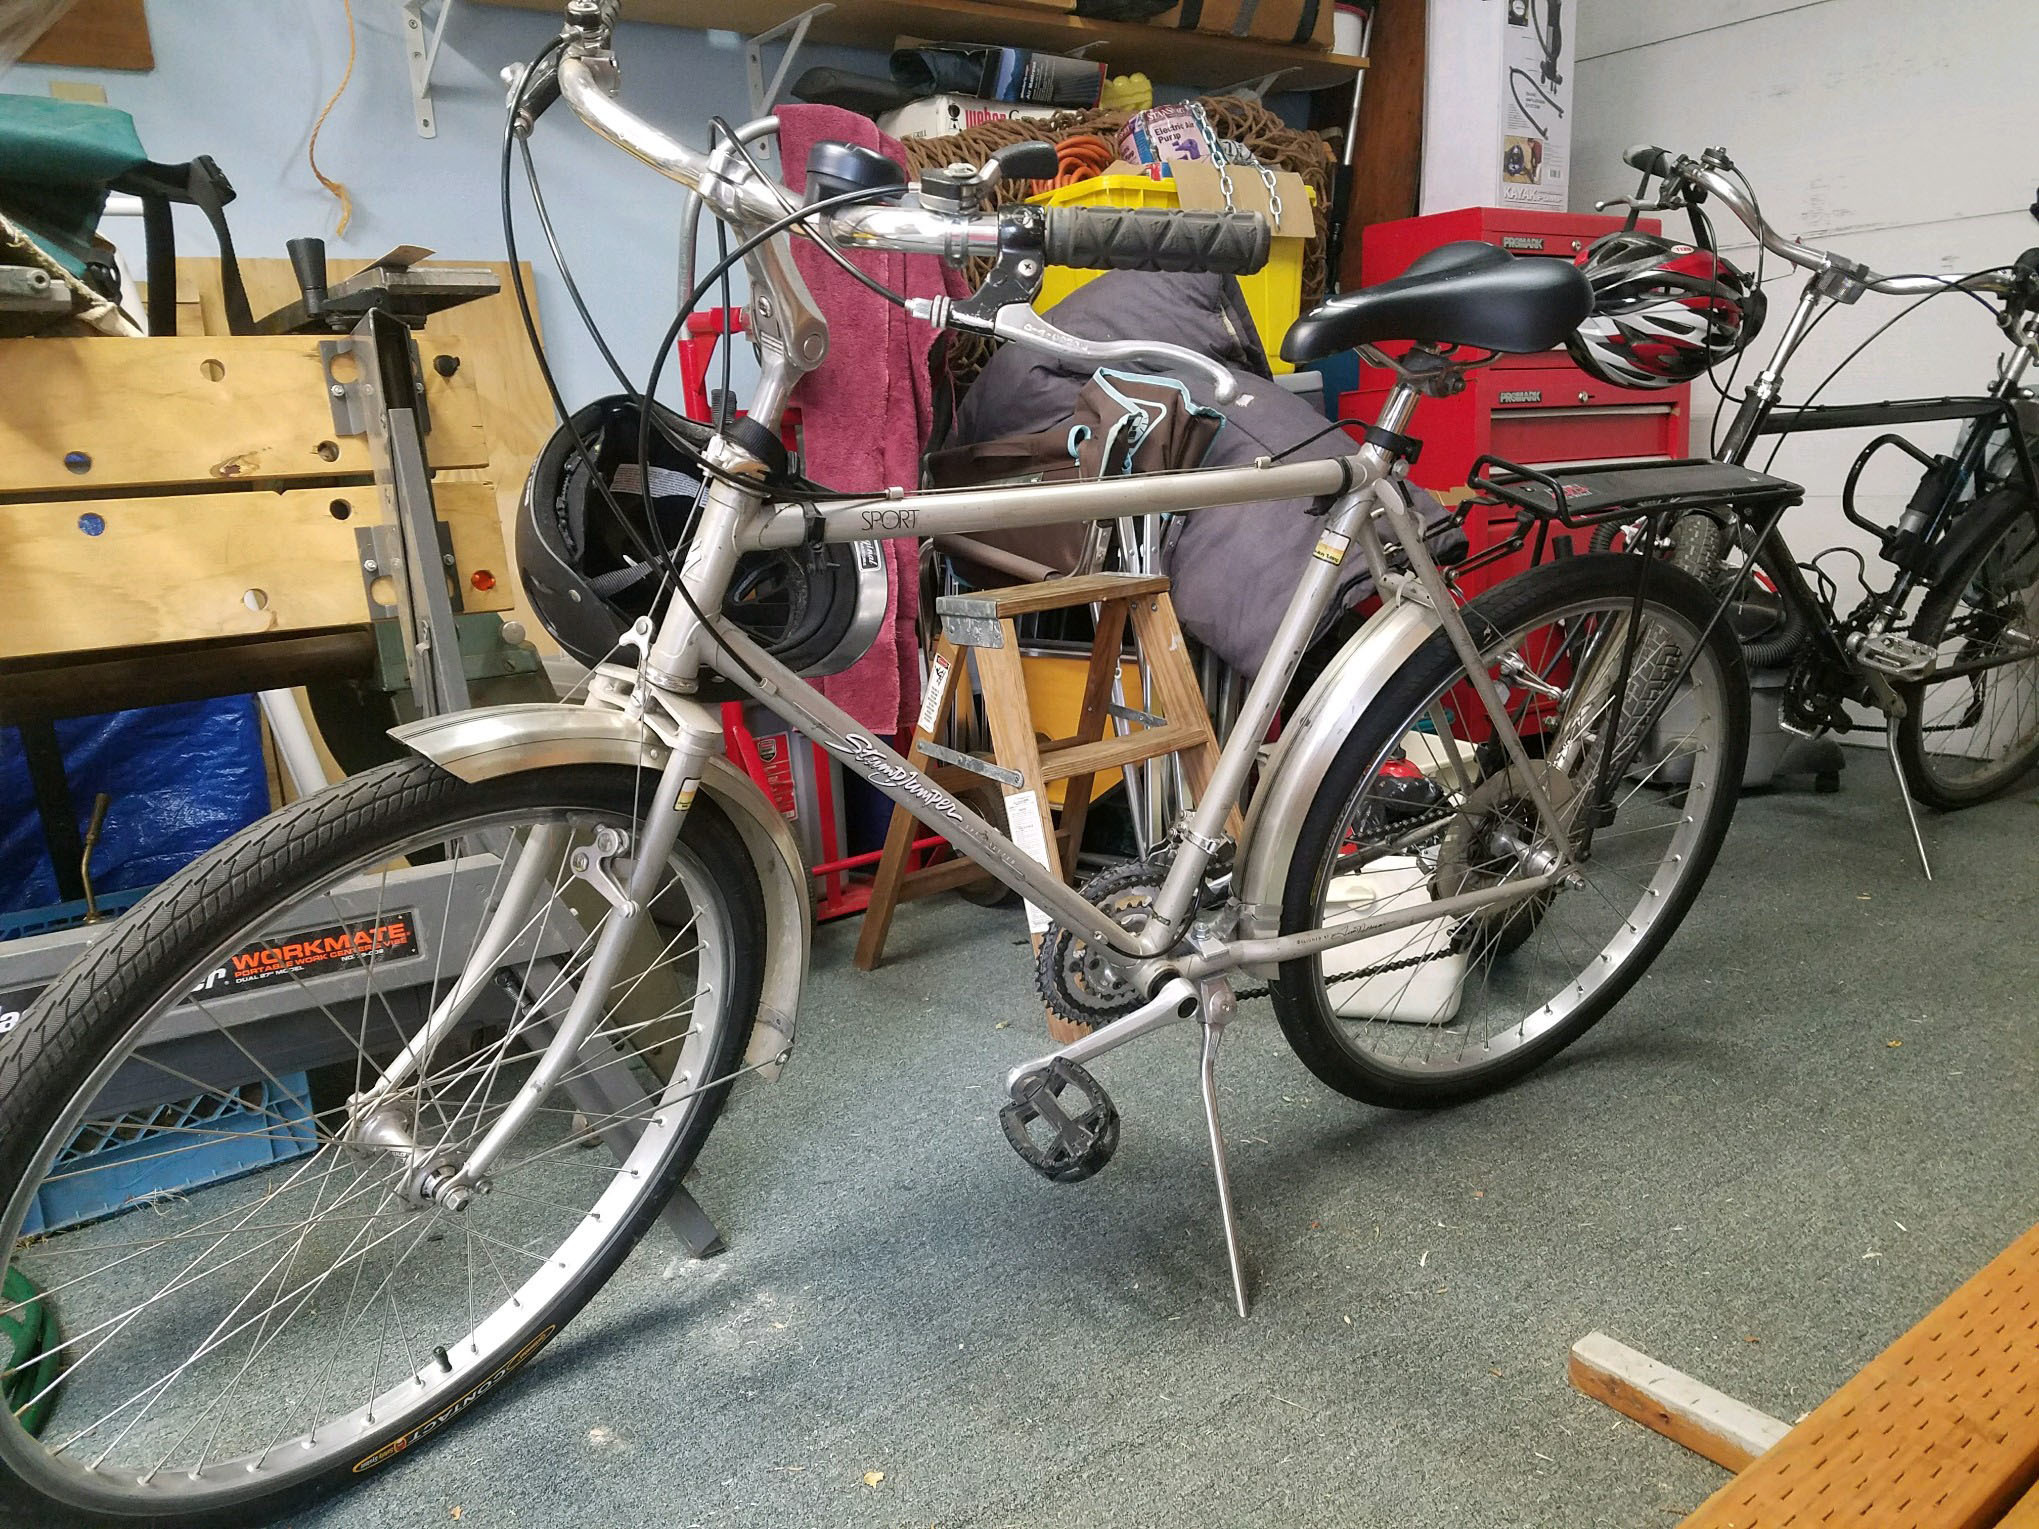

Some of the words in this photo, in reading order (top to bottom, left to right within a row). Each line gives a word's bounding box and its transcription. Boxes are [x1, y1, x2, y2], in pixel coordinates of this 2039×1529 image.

[1503, 236, 1543, 249] PROMARK
[1500, 391, 1541, 403] PROMARK
[861, 509, 920, 531] SPORT
[231, 923, 405, 971] WORKMATE
[235, 975, 259, 984] DUAL
[409, 1369, 506, 1441] CONTACT
